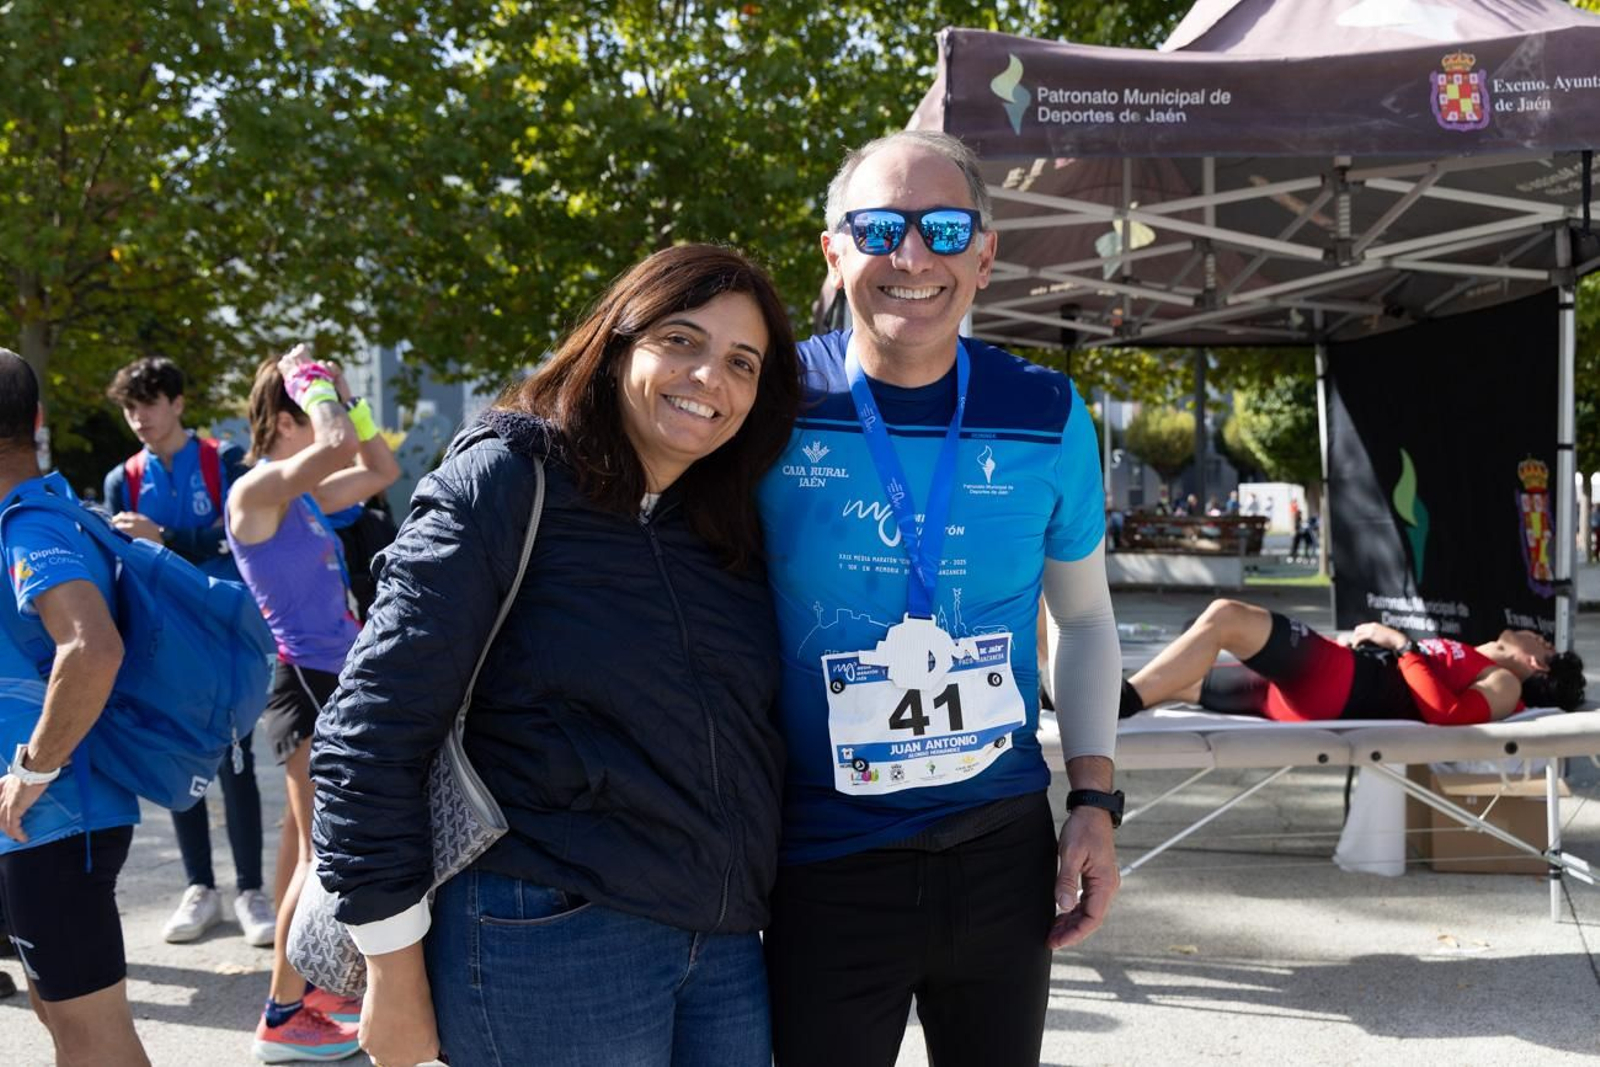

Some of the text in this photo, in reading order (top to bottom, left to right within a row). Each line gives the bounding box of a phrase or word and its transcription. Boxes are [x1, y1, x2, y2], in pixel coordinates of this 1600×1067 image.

[1553, 75, 1600, 92] Ayunt
[1037, 87, 1231, 108] Patronato Municipal de
[1494, 96, 1551, 112] de Jaén
[1038, 107, 1187, 124] Deportes de Jaén
[810, 466, 849, 478] RURAL
[799, 476, 827, 488] JAÉN
[888, 683, 963, 736] 41
[890, 735, 978, 756] JUAN ANTONIO
